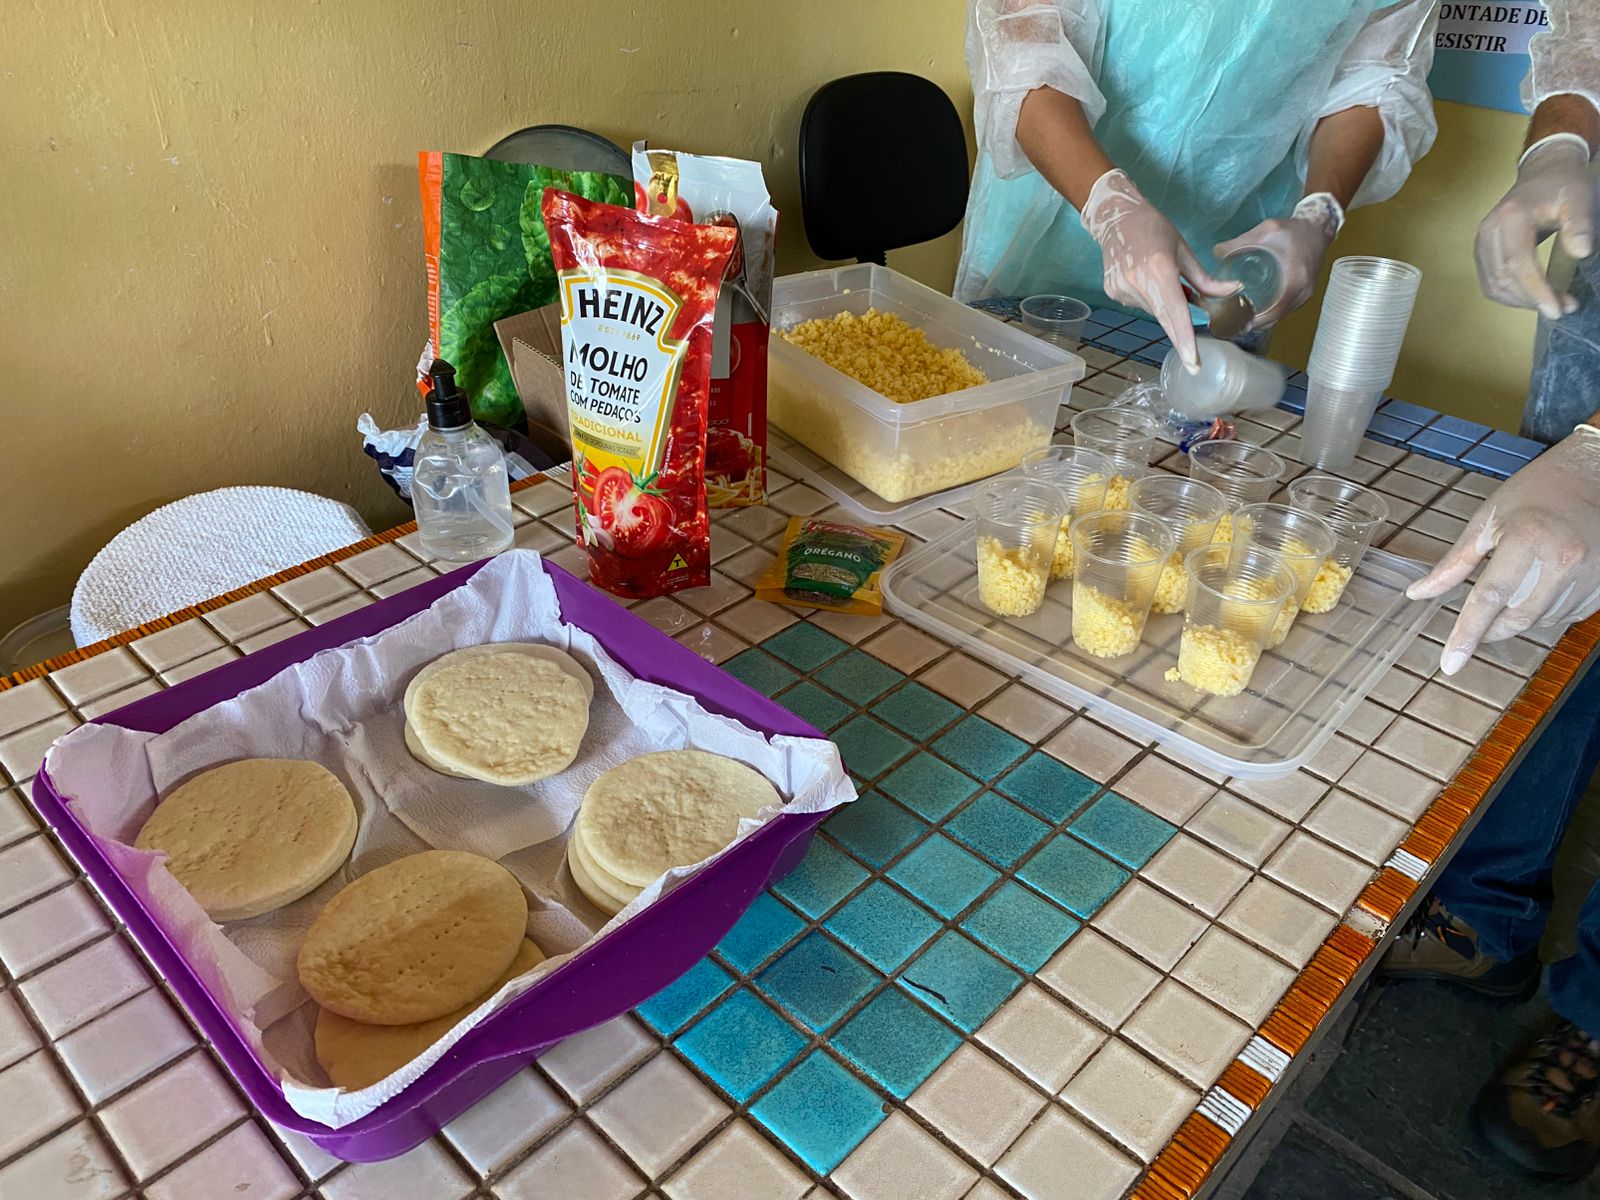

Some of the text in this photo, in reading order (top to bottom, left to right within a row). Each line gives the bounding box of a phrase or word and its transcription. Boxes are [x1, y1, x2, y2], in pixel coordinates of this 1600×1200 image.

[1440, 4, 1549, 26] ONTADE DE
[1435, 32, 1507, 52] ESISTIR
[578, 288, 664, 336] HEINZ
[569, 338, 648, 382] MOLHO
[571, 370, 641, 405] DE TOMATE
[570, 389, 641, 424] COM PEDAÇOS
[571, 409, 643, 443] TRADICIONAL
[804, 548, 861, 563] ORÉGANO
